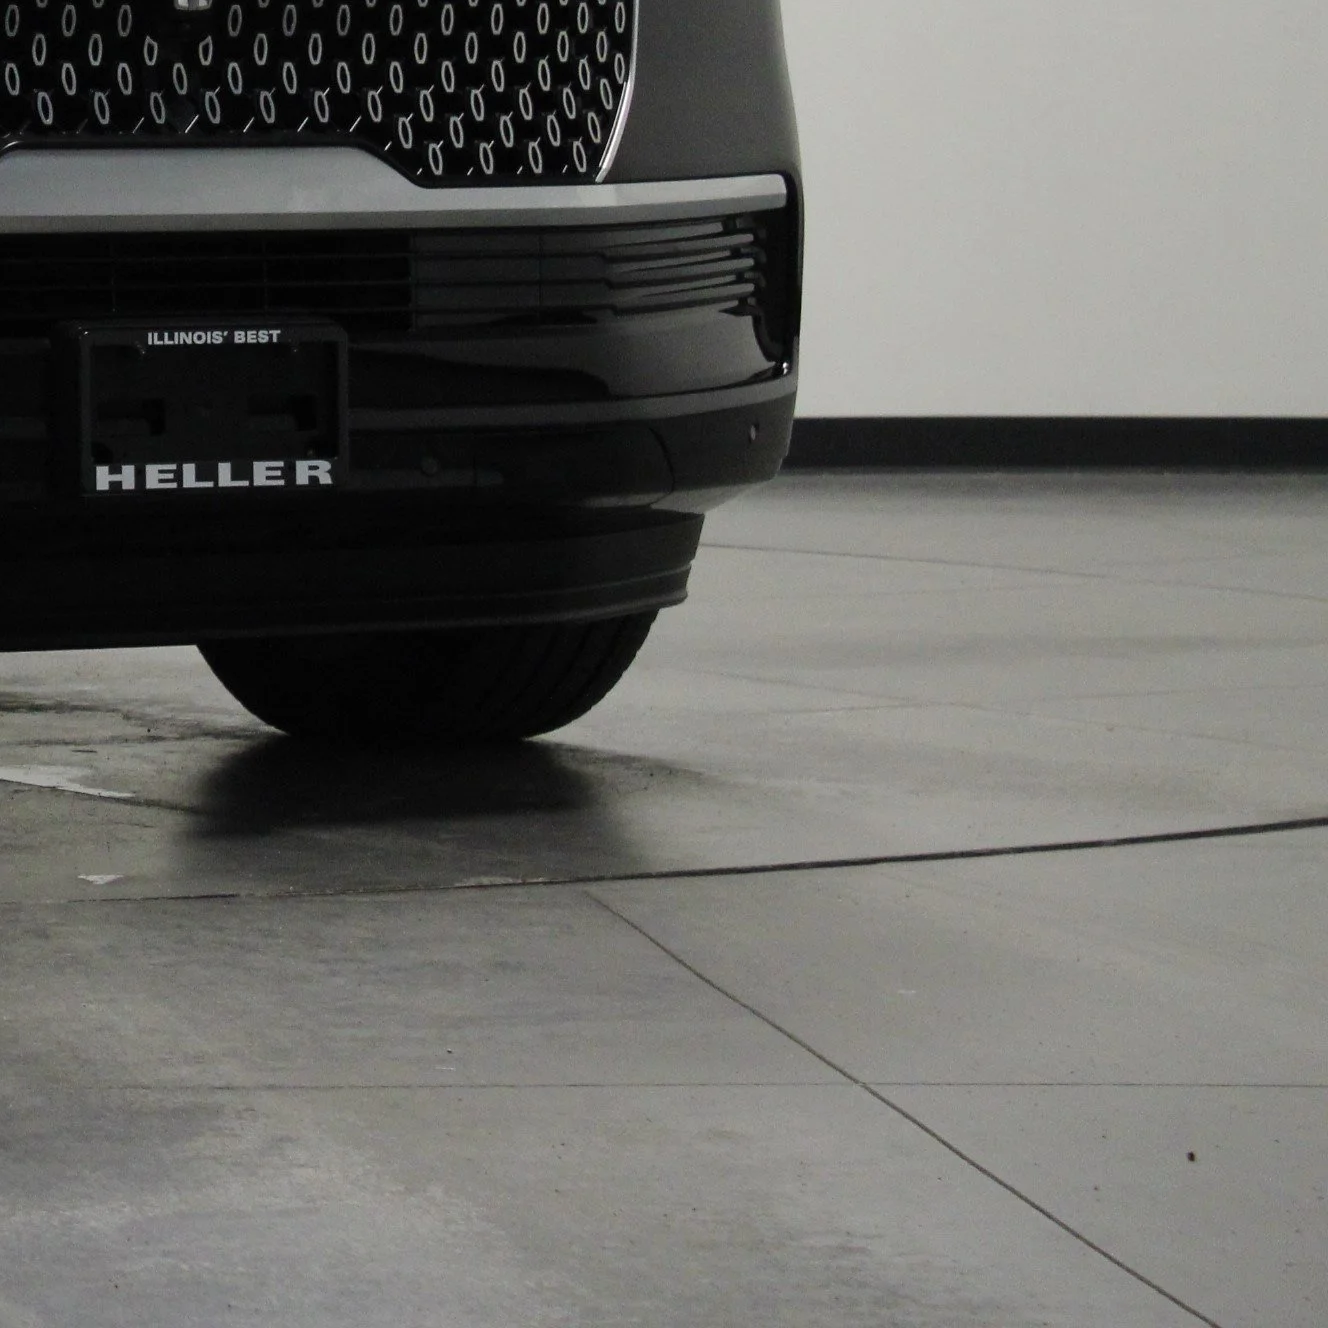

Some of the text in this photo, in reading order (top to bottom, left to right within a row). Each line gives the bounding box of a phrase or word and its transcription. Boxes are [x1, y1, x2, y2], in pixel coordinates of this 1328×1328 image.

[147, 329, 282, 346] ILLINOIS' BEST
[95, 459, 334, 491] HELLER
